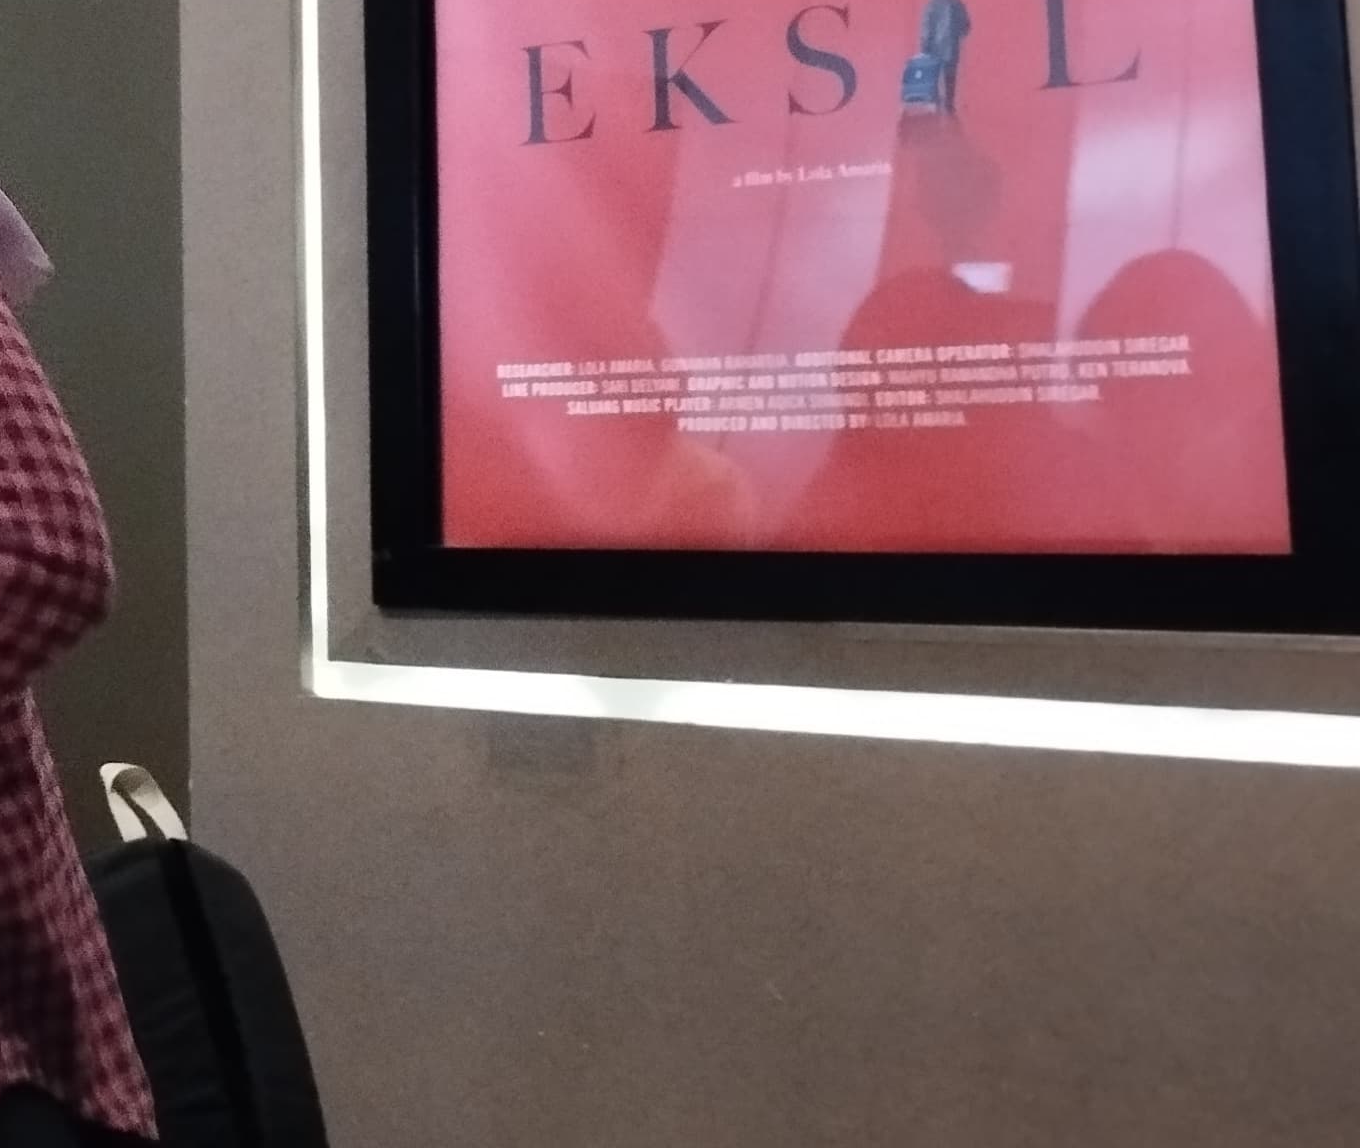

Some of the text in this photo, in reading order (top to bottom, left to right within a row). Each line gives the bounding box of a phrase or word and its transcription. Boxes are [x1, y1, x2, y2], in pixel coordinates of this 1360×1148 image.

[744, 171, 773, 186] film
[776, 169, 793, 184] by
[798, 166, 832, 182] Lola
[502, 383, 528, 397] LINE
[748, 373, 774, 390] AND
[750, 415, 778, 431] AND
